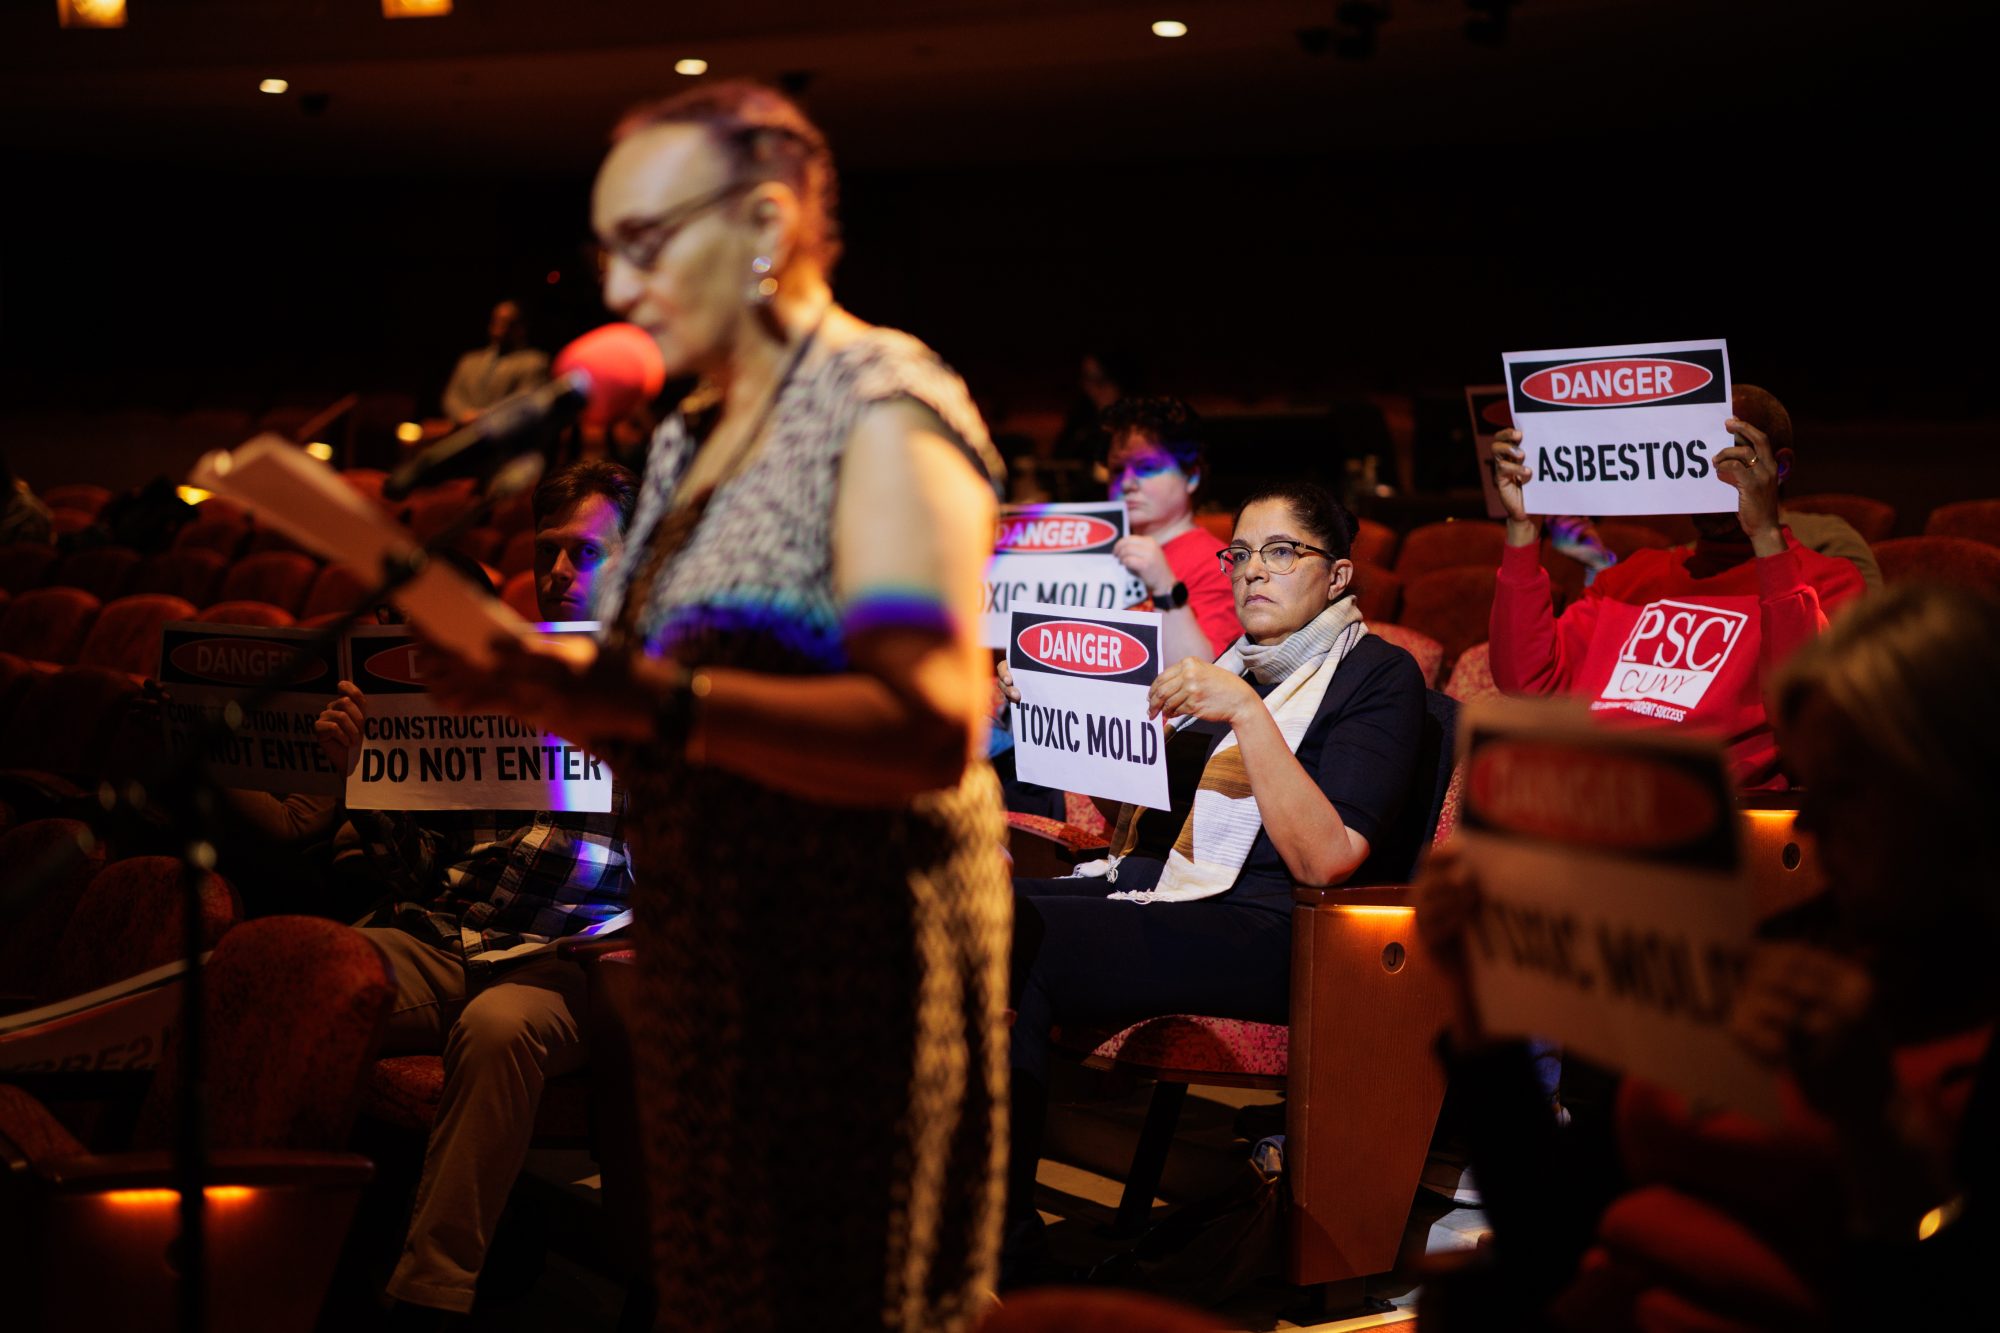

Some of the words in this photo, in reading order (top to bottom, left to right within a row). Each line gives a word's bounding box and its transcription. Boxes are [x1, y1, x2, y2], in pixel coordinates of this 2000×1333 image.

[1550, 365, 1674, 400] DANGER
[1538, 439, 1709, 482] ASBESTOS
[995, 520, 1091, 547] DANGER
[1039, 628, 1122, 668] DANGER
[1621, 608, 1736, 672] PSC
[1619, 669, 1697, 694] CUNY
[364, 714, 537, 740] CONSTRUCTION
[1016, 702, 1081, 753] TOXIC
[1086, 713, 1158, 765] MOLD
[261, 737, 337, 773] ENTE
[362, 748, 409, 782] DO
[420, 747, 486, 782] NOT
[496, 745, 602, 781] ENTER
